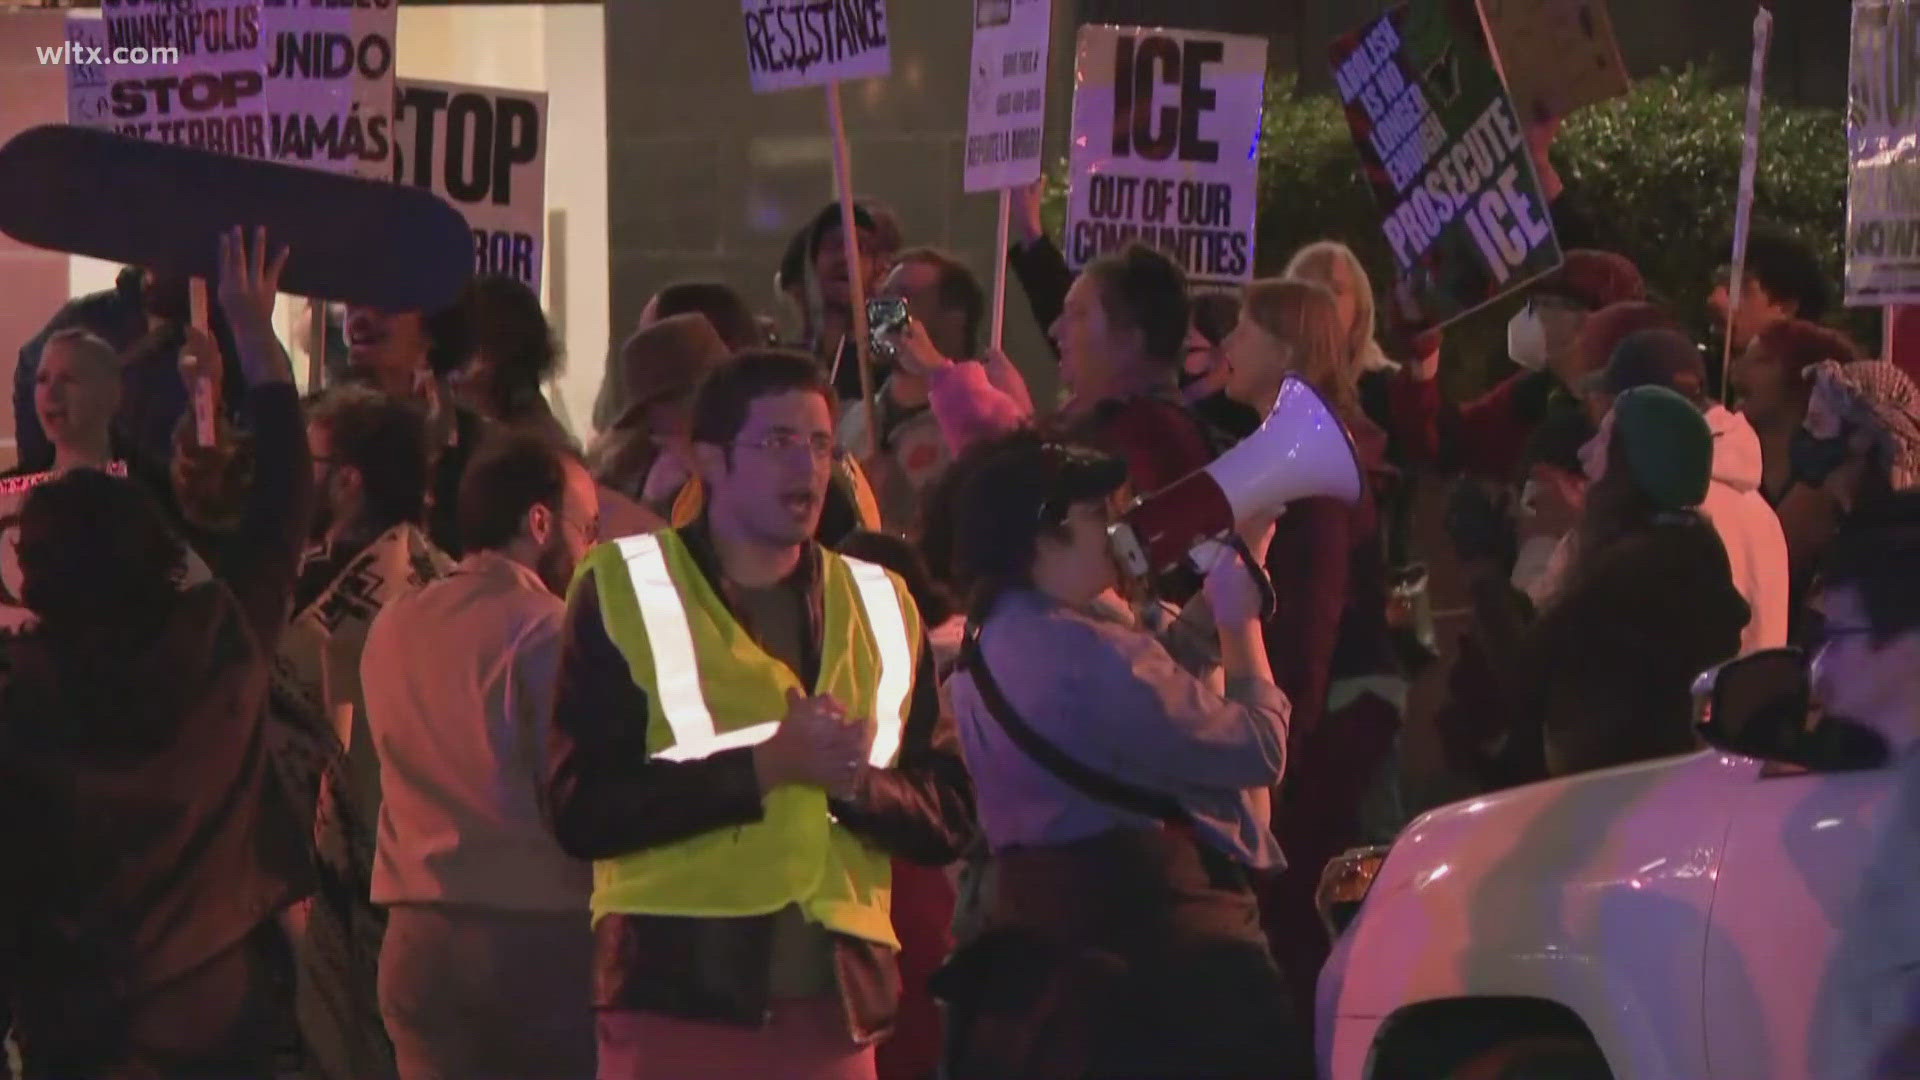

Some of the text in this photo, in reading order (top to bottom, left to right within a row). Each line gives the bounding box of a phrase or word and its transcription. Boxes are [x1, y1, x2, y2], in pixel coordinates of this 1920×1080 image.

[107, 5, 259, 58] MINNEAPOLIS
[745, 0, 886, 74] RESISTANCE
[111, 70, 263, 118] STOP
[1112, 35, 1224, 163] ICE
[1360, 59, 1404, 121] IS NO
[1369, 83, 1430, 162] LONGER
[1382, 97, 1525, 268] PROSECUTE
[1386, 110, 1447, 193] ENOUGH
[1089, 173, 1232, 227] OUT OF OUR
[1464, 163, 1551, 284] ICE
